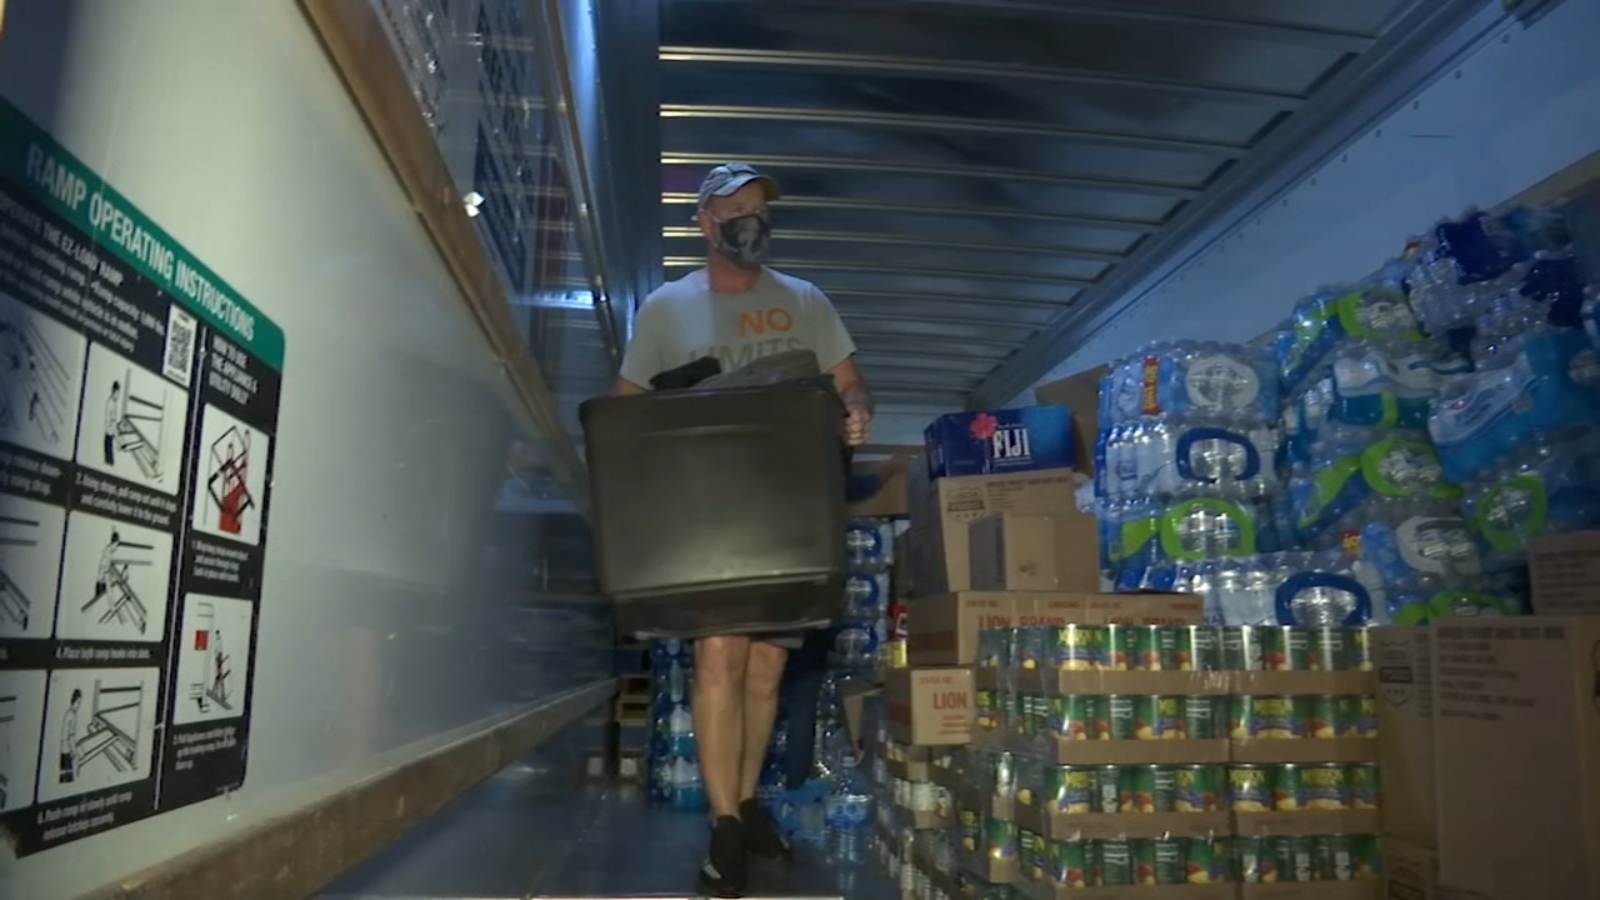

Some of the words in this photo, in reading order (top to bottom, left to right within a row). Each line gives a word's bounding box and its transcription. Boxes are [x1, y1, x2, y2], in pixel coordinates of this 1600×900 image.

[27, 142, 87, 210] RAMP
[89, 191, 174, 281] OPERATING
[175, 258, 255, 342] INSTRUCTIONS
[738, 308, 793, 338] NO
[993, 428, 1030, 458] FIJI
[933, 691, 967, 709] LION
